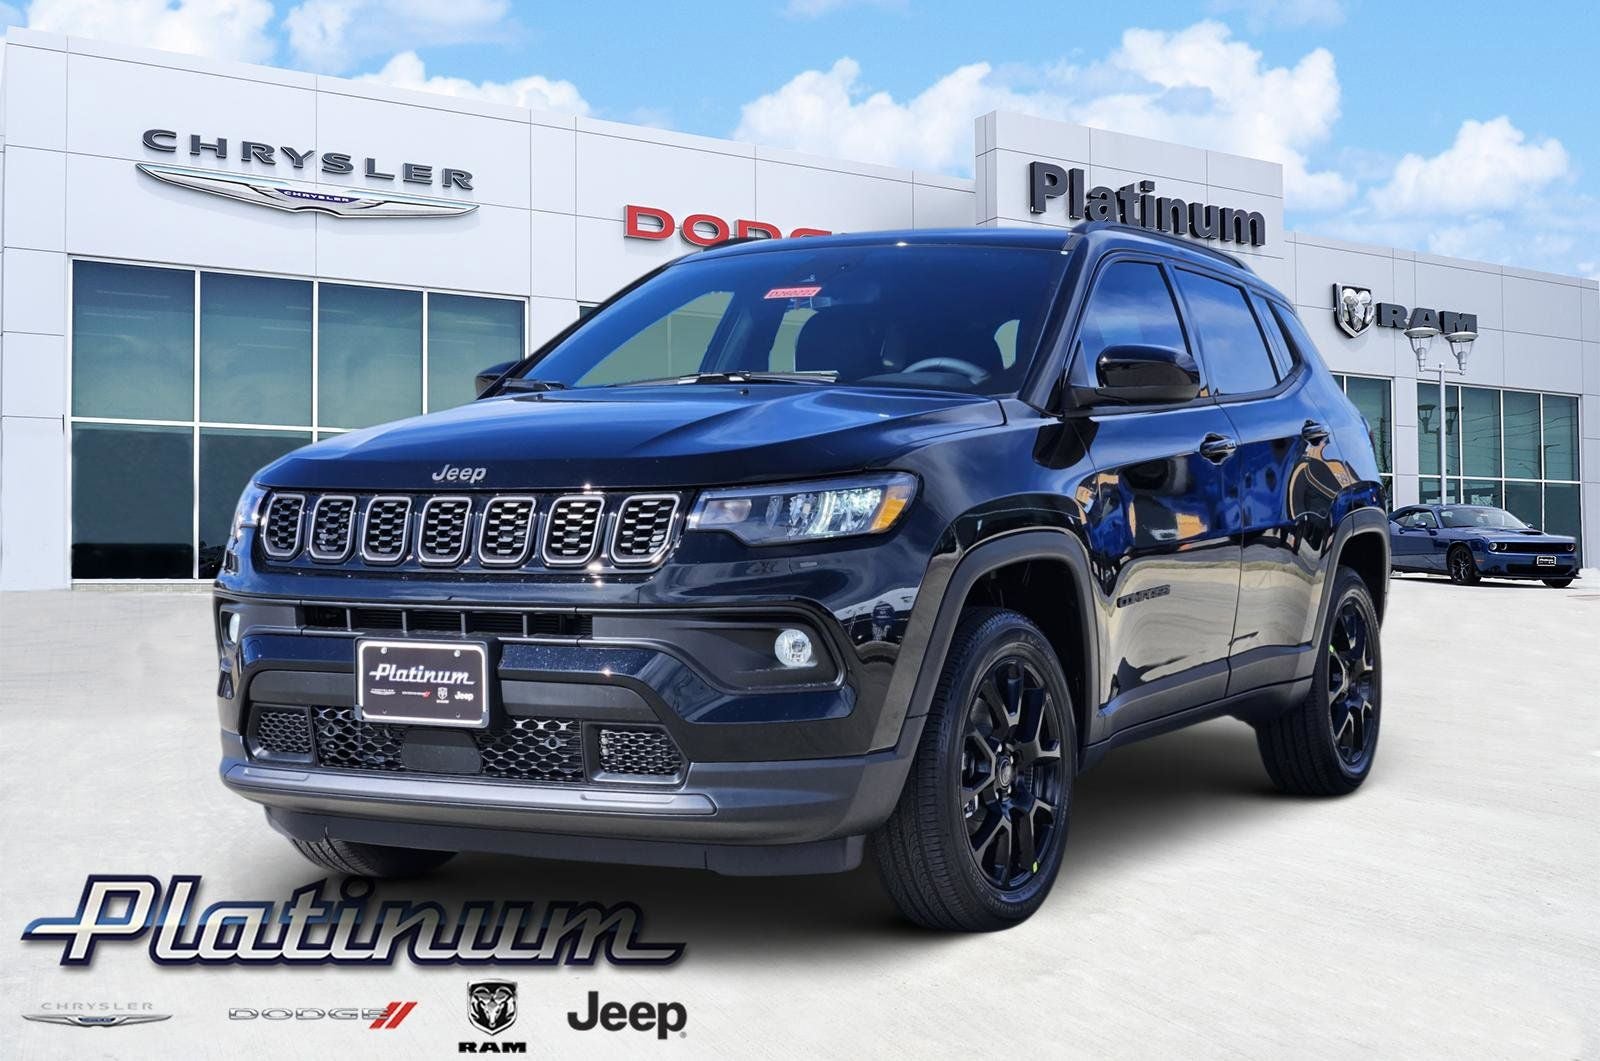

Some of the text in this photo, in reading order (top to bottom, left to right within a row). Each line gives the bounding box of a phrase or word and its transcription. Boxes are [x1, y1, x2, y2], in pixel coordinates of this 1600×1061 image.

[142, 128, 474, 190] CHRYSLER
[284, 190, 350, 203] CHRYSLER
[1029, 161, 1266, 246] Platinum
[623, 204, 832, 247] DOD
[1376, 302, 1477, 335] RAM
[432, 464, 487, 484] Jeep
[369, 663, 476, 685] Platinum
[454, 691, 474, 701] Jeep
